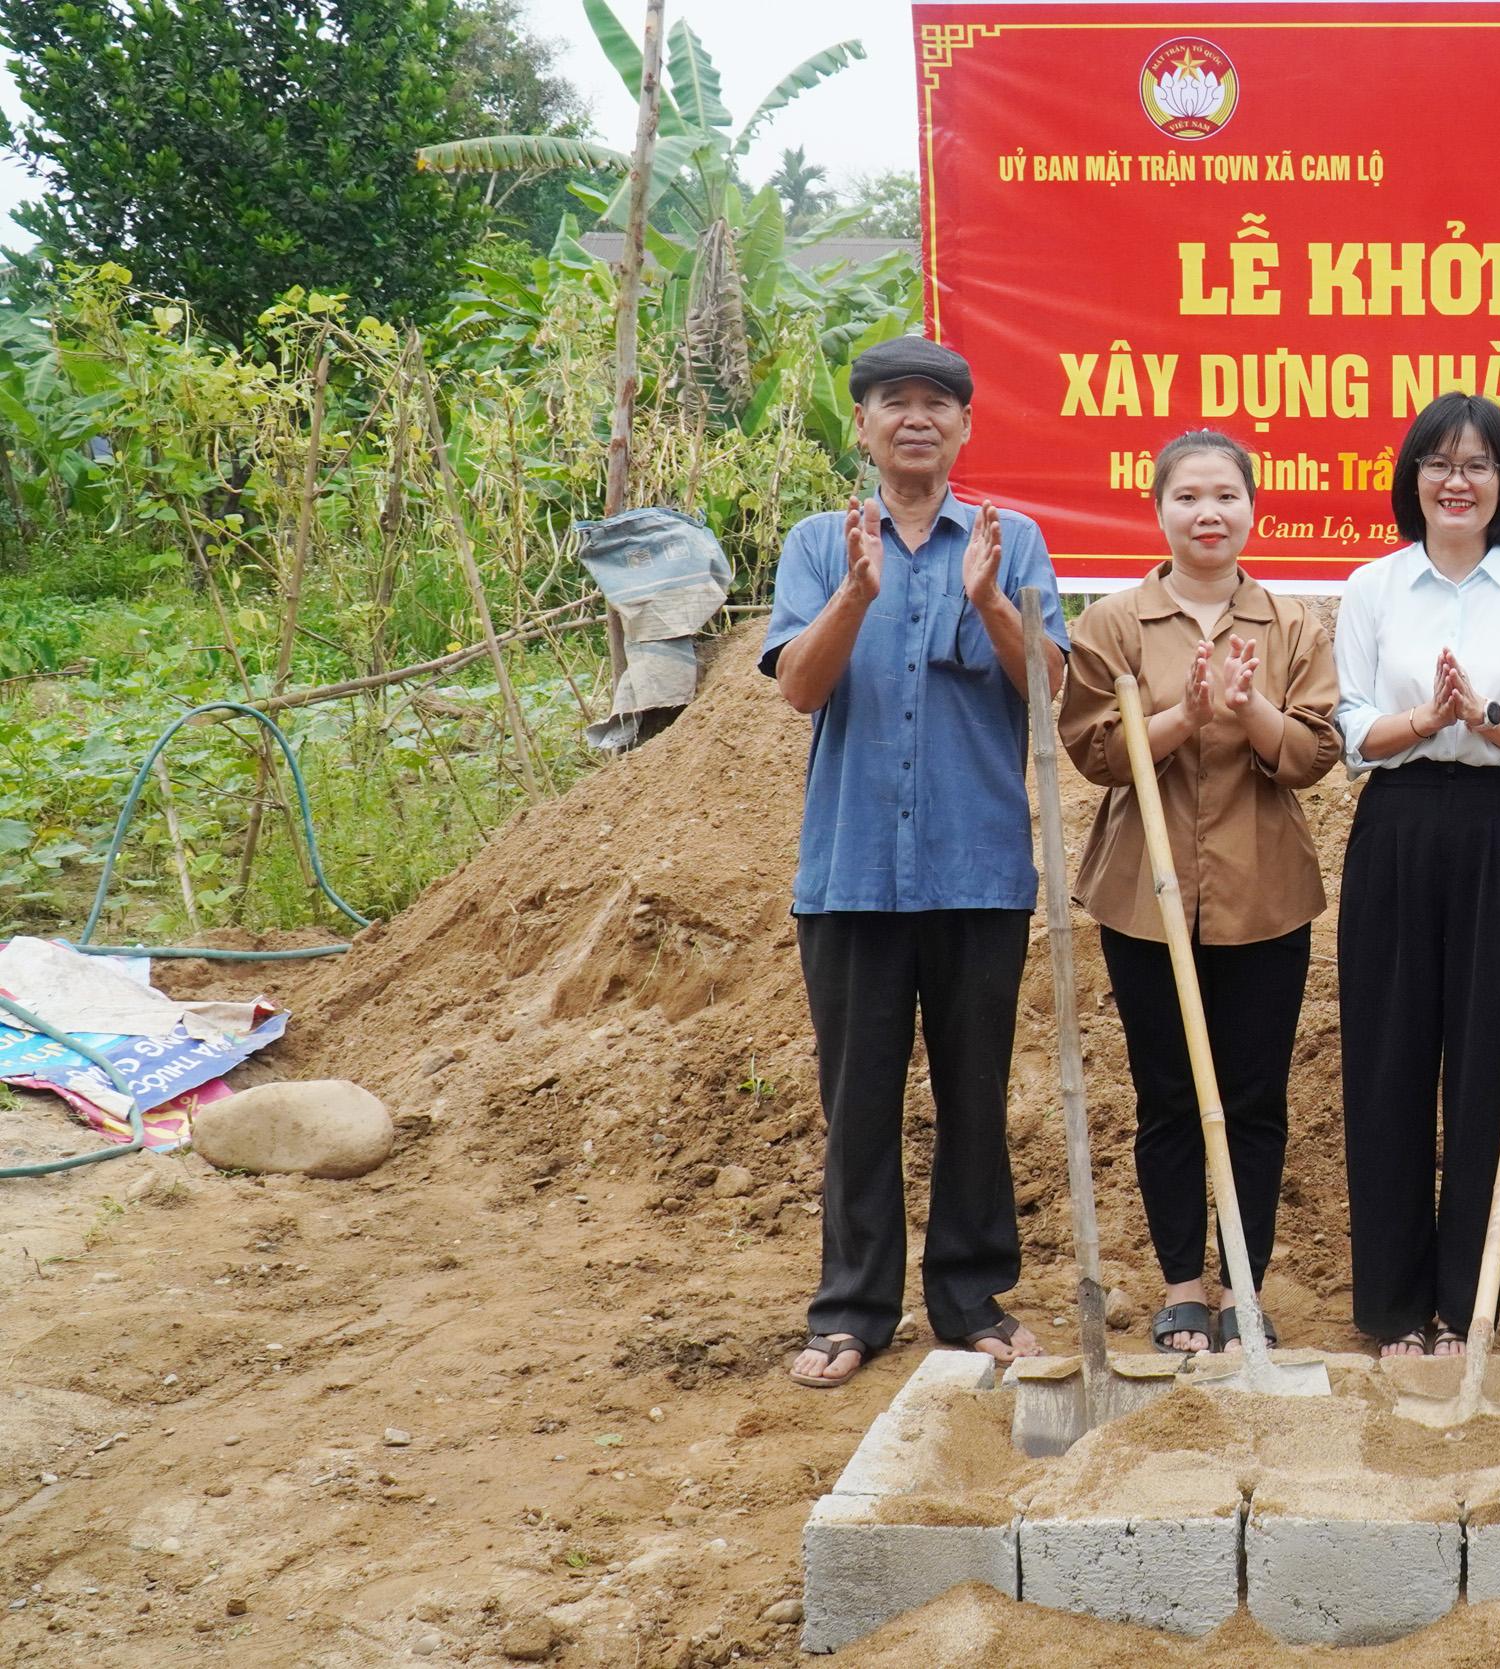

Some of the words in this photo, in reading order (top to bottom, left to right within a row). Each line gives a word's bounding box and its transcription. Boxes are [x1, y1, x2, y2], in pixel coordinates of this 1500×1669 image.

[999, 147, 1027, 182] UỶ
[1033, 155, 1079, 182] BAN
[1085, 150, 1133, 187] MẶT
[1137, 150, 1196, 187] TRẬN
[1201, 154, 1259, 184] TQVN
[1264, 150, 1295, 182] XÃ
[1301, 154, 1351, 182] CAM
[1357, 149, 1384, 187] LỘ
[1178, 212, 1282, 316] LỄ
[1058, 339, 1179, 417] XÂY
[1200, 347, 1369, 433] DỰNG
[1110, 451, 1157, 499] Hộ
[1337, 446, 1394, 492] Trầ
[1257, 515, 1315, 540] Cam
[1321, 516, 1361, 546] Lộ,
